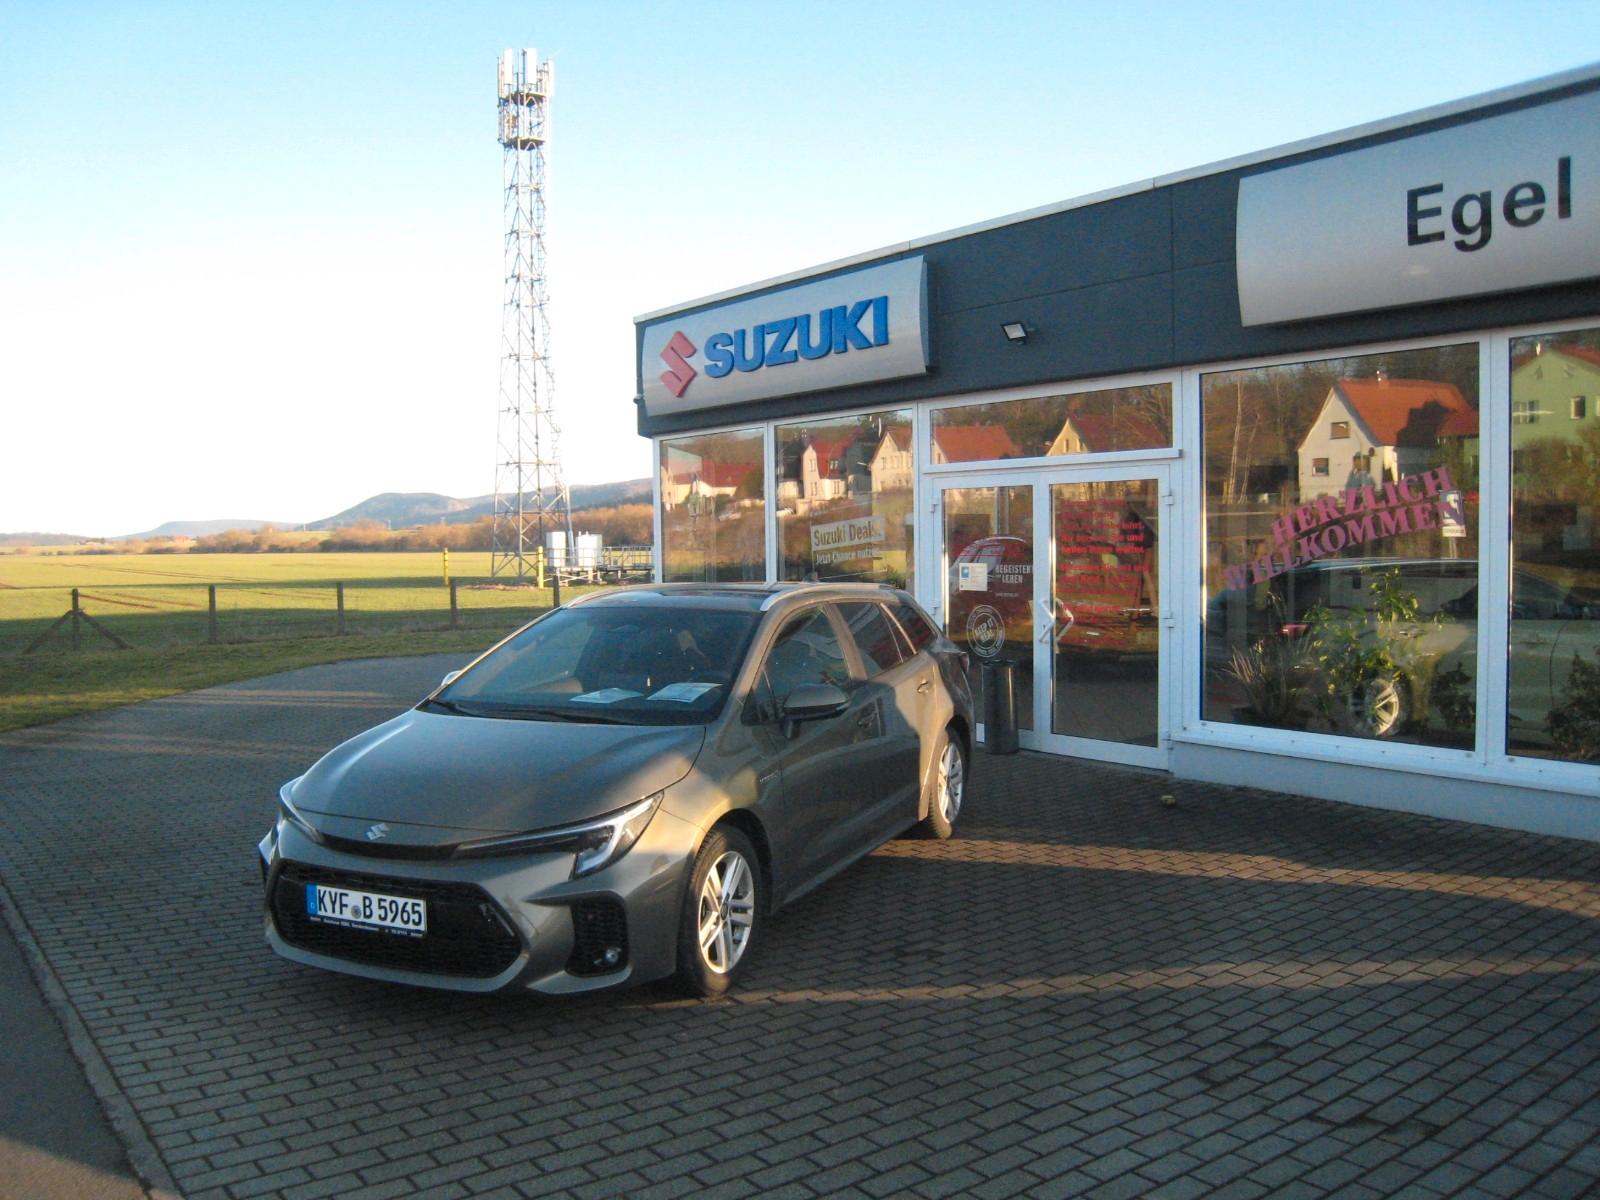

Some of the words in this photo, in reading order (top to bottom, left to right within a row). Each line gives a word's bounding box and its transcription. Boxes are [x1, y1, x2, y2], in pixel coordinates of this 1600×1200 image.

[1407, 156, 1571, 252] Egel
[704, 296, 889, 379] SUZUKI
[814, 525, 846, 547] Suzuki
[1271, 465, 1454, 545] HERZLICH
[995, 564, 1033, 574] BEGEISTER
[1224, 499, 1465, 592] WILLKOMMEN
[318, 889, 349, 915] KYF
[363, 896, 373, 919] B
[378, 898, 422, 926] 5965
